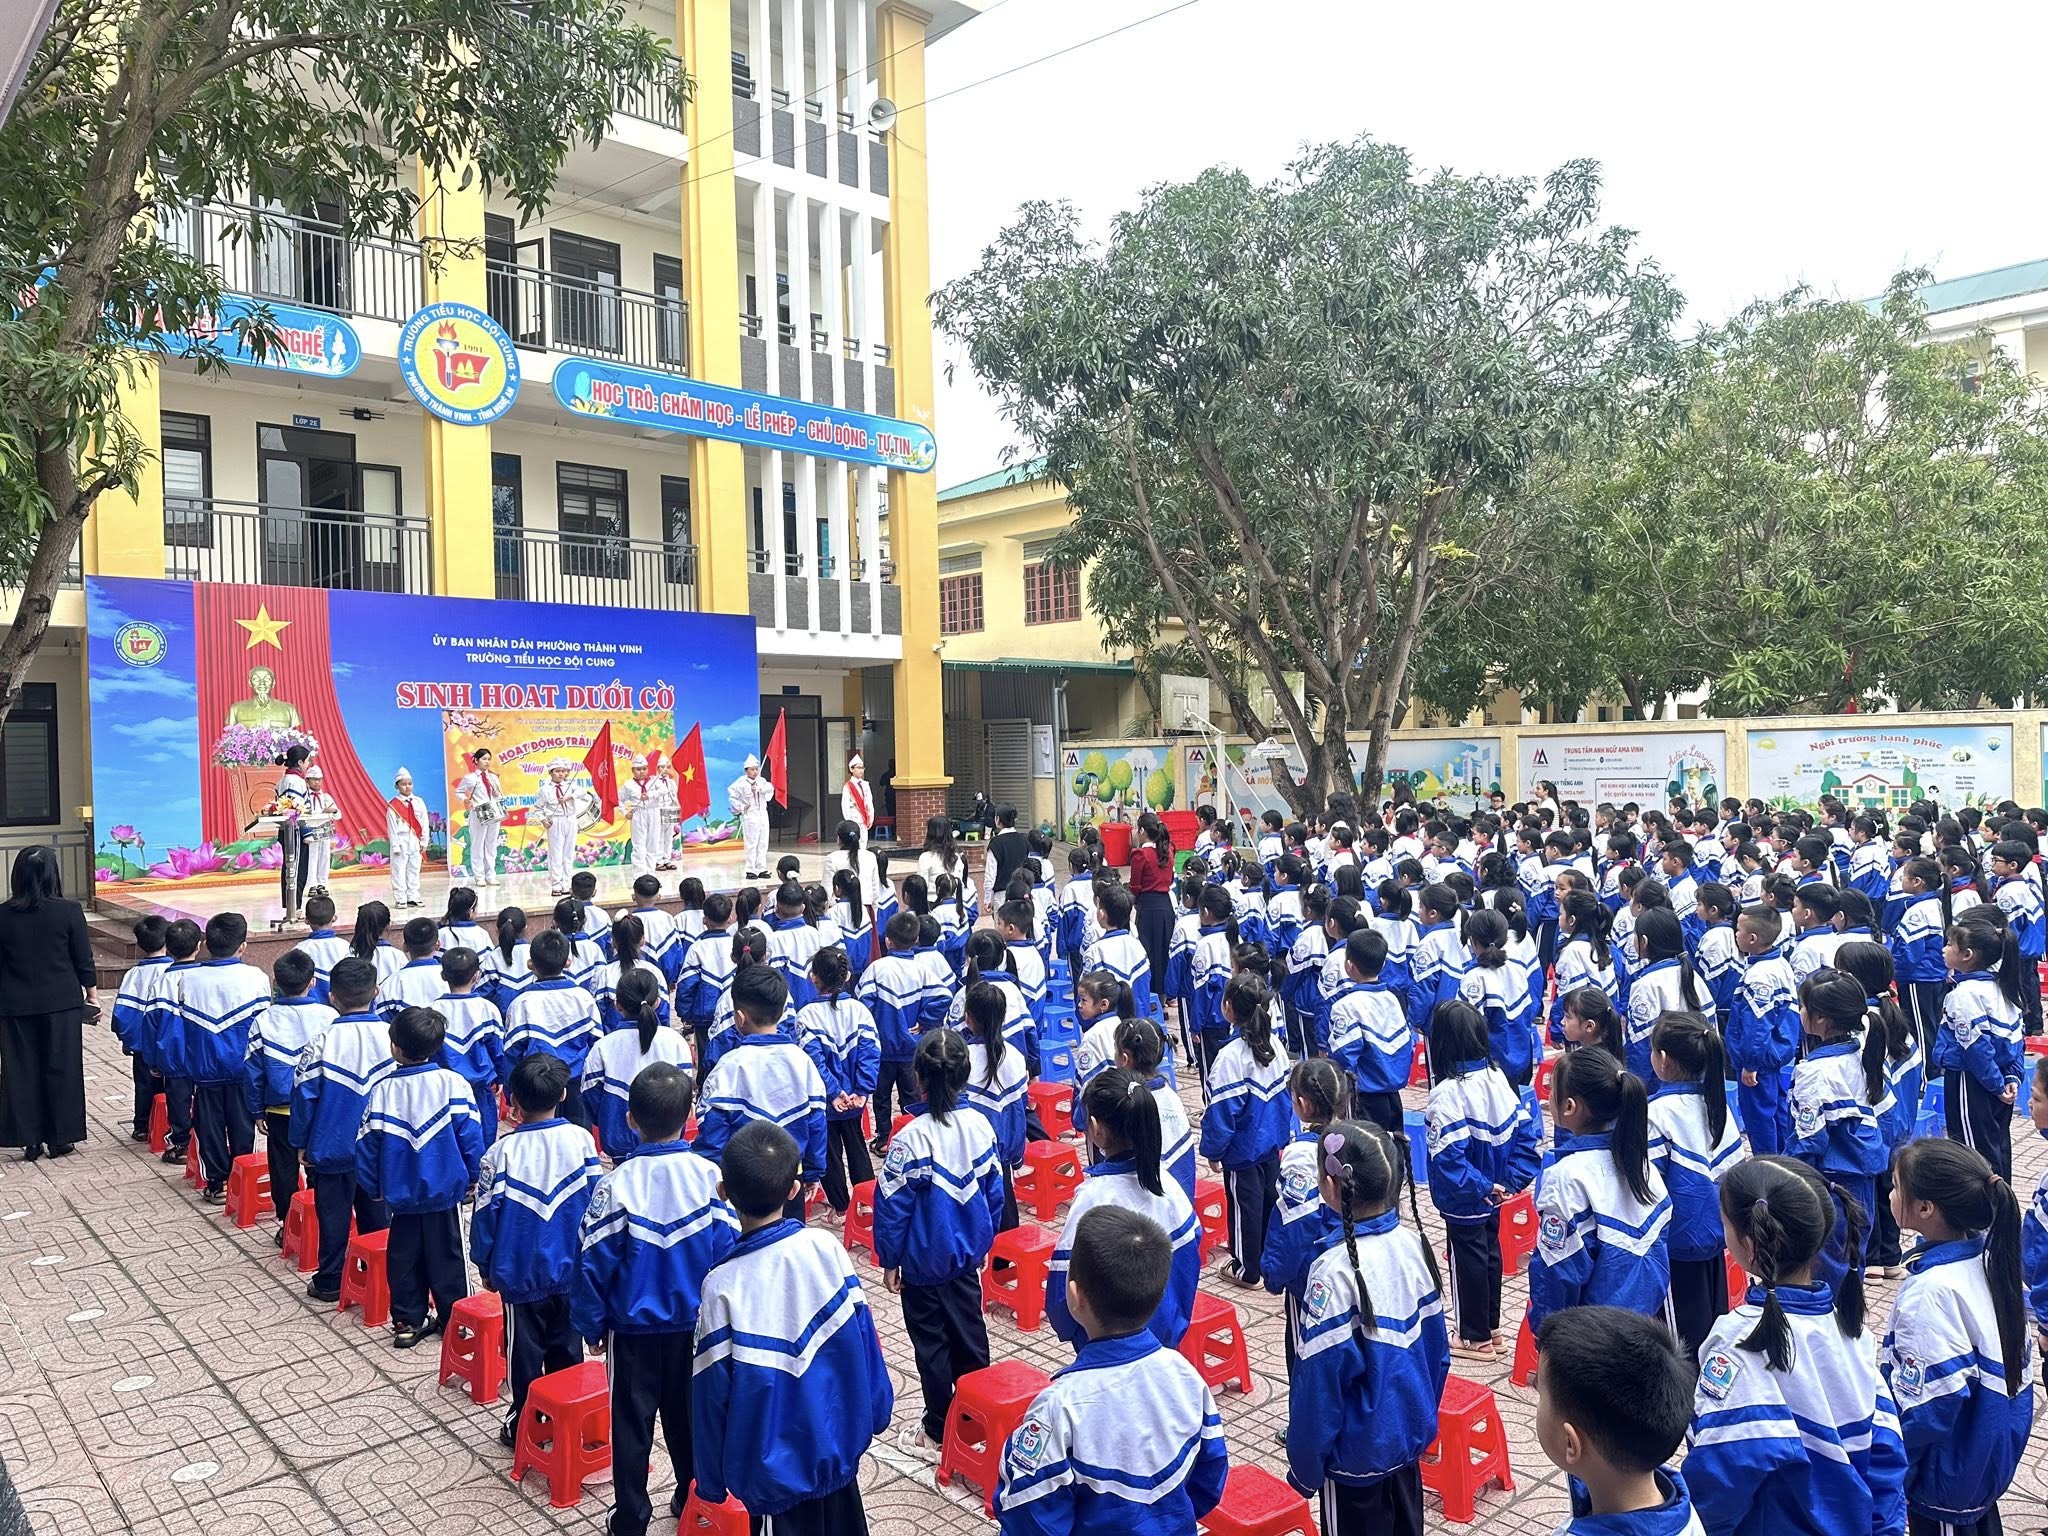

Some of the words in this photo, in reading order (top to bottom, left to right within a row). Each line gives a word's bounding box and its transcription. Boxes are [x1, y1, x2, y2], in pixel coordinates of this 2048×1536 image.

[403, 313, 430, 352] TRƯỜNG
[429, 302, 454, 319] TIỂU
[457, 308, 481, 321] HỌC
[481, 319, 499, 337] ĐỘI
[500, 340, 516, 370] CUNG
[406, 371, 430, 402] PHƯỜNG
[428, 400, 453, 418] THÀNH
[453, 411, 473, 422] VINH
[477, 409, 495, 420] TỈNH
[493, 395, 511, 414] NGHỆ
[506, 386, 515, 399] AN
[592, 381, 622, 408] HỌC
[626, 385, 658, 411] TRÒ:
[662, 392, 702, 419] CHĂM
[706, 402, 733, 427] HỌC
[745, 403, 760, 429] LỄ
[764, 411, 796, 435] PHÉP
[808, 418, 832, 441] CHỦ
[835, 423, 867, 449] ĐỘNG
[877, 433, 892, 456] TỰ
[893, 436, 911, 455] TIN
[433, 633, 447, 646] ỦY
[451, 637, 473, 647] BAN
[477, 636, 508, 649] NHÂN
[511, 637, 534, 649] DÂN
[537, 640, 581, 651] PHƯỜNG
[583, 641, 617, 653] THÀNH
[619, 644, 642, 654] VINH
[466, 652, 511, 663] TRƯỜNG
[513, 651, 535, 664] TIỂU
[538, 655, 561, 667] HỌC
[564, 655, 583, 668] ĐỘI
[586, 657, 615, 667] CUNG
[397, 681, 472, 708] SINH
[567, 679, 632, 710] DƯỚI
[640, 680, 675, 710] CỜ
[498, 744, 530, 763] HOẠT
[565, 735, 590, 748] TRẢI
[1582, 746, 1593, 754] TÂM
[1606, 745, 1617, 753] NGỮ
[1809, 738, 1835, 751] Ngôi
[1838, 734, 1876, 744] trường
[1880, 734, 1909, 744] hạnh
[1912, 737, 1943, 750] phúc
[1560, 778, 1573, 786] TIẾNG
